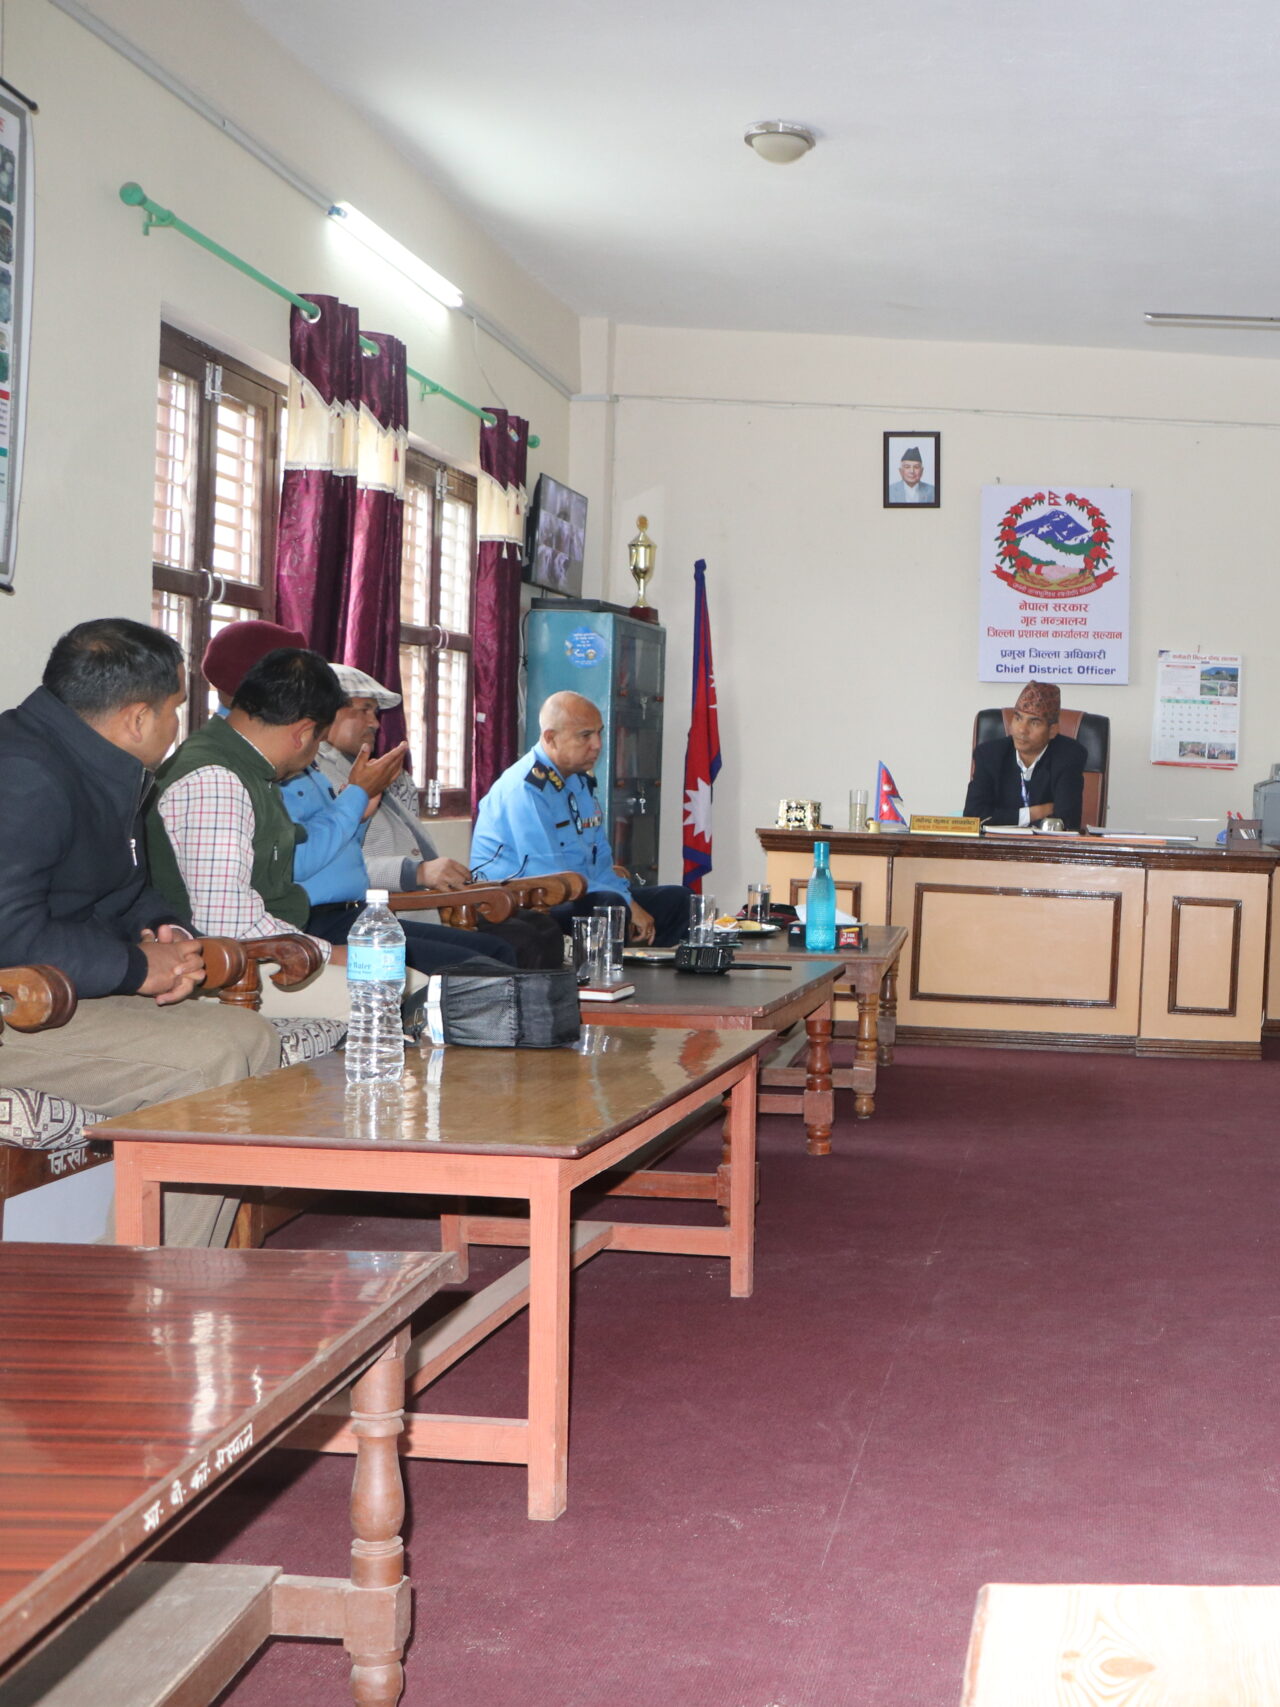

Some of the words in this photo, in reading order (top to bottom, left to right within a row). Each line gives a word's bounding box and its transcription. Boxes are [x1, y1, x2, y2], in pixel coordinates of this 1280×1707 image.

[1019, 600, 1048, 612] नेपाल
[1052, 603, 1089, 612] सरकार
[1020, 616, 1037, 626] गृह
[1040, 616, 1087, 626] मन्त्रालय
[987, 627, 1015, 638] जिल्ला
[1017, 629, 1049, 639] प्रशासन
[1052, 629, 1089, 639] कार्यालय
[1092, 631, 1122, 640] सल्यान
[1000, 649, 1026, 660] प्रमुख
[1029, 647, 1060, 659] जिल्ला
[1063, 648, 1106, 660] अधिकारी
[995, 664, 1025, 673] Chief
[1028, 664, 1073, 674] District
[1077, 666, 1116, 676] Officer
